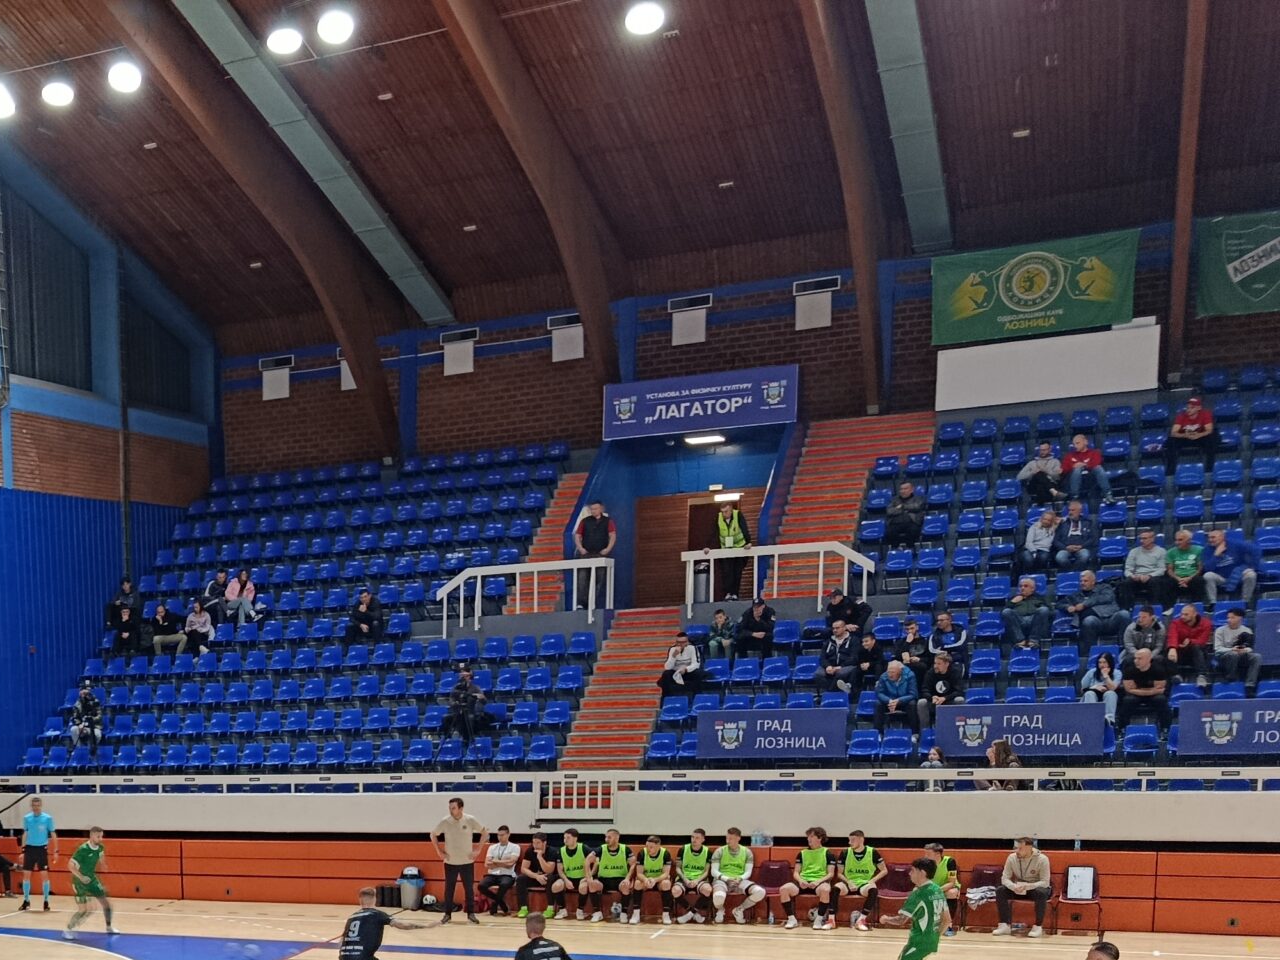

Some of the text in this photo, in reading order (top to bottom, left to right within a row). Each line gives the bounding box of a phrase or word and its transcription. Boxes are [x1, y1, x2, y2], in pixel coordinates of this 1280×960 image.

[645, 396, 752, 424] „ЛАГАТОР“
[756, 719, 792, 733] ГРАД
[1003, 715, 1043, 729] ГРАД
[754, 736, 826, 750] ЛОЗНИЦА
[1252, 730, 1280, 743] ЛО
[348, 920, 361, 938] 9
